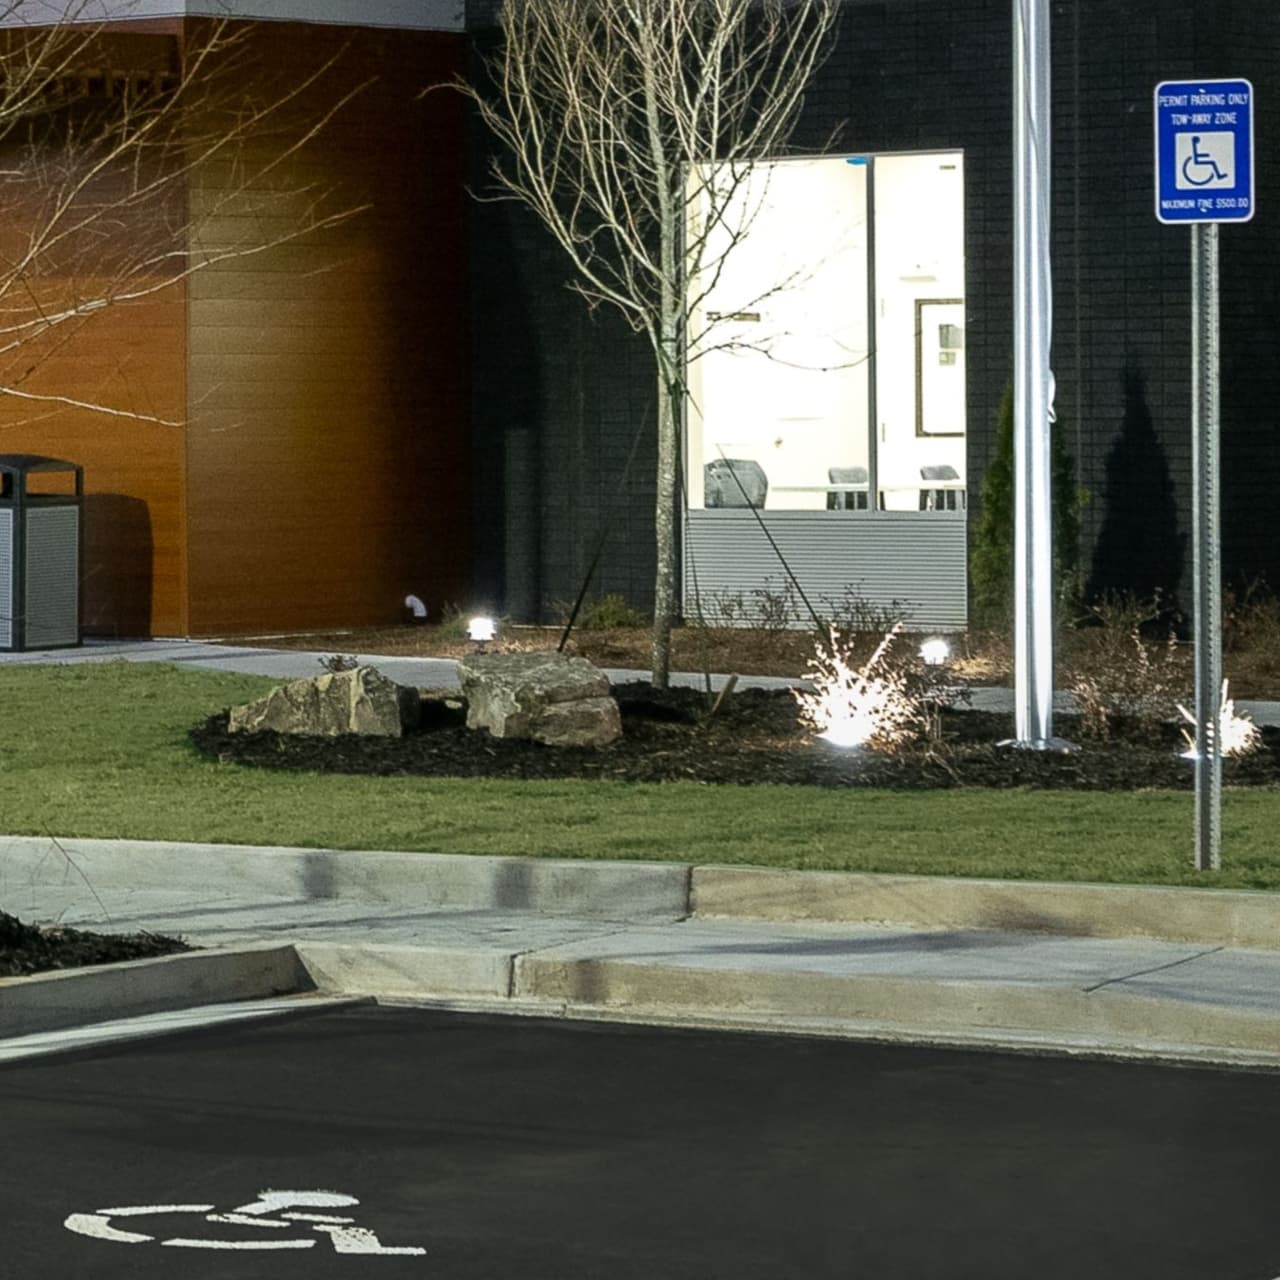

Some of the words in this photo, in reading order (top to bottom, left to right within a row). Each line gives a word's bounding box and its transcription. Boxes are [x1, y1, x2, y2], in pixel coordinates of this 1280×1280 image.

[1159, 94, 1188, 107] PERMIT
[1190, 93, 1226, 106] PARKING
[1228, 93, 1249, 106] ONLY
[1170, 113, 1212, 126] TOW-AWAY
[1214, 111, 1238, 125] ZONE
[1197, 198, 1214, 209] FINE
